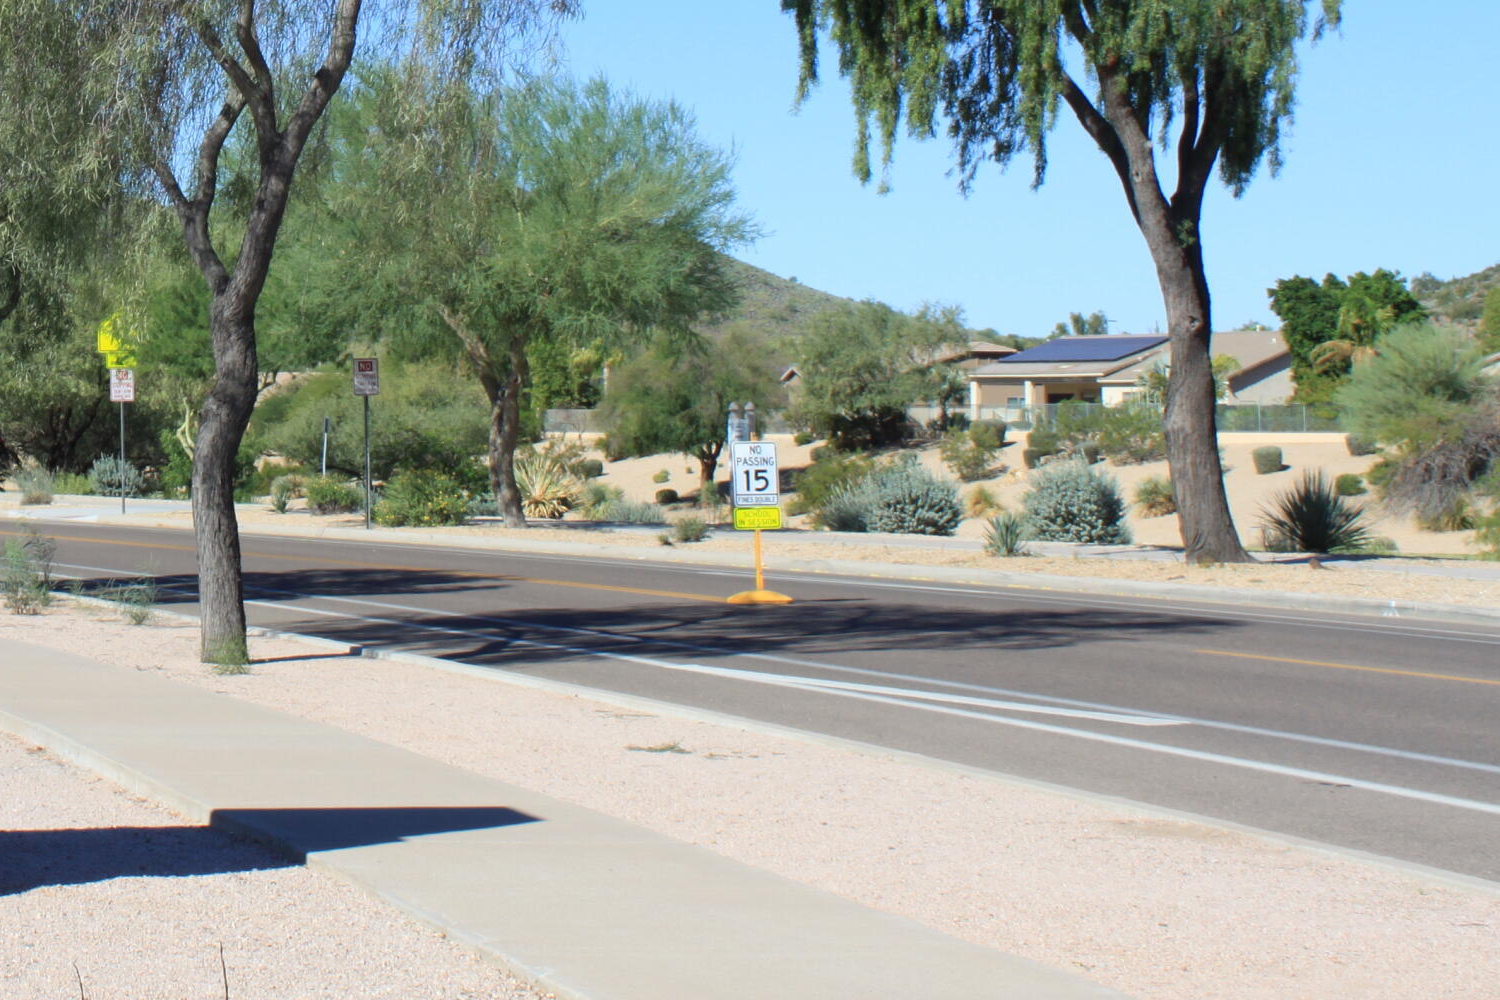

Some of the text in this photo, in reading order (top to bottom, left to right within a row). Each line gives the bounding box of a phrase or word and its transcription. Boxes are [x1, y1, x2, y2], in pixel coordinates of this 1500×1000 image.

[749, 445, 762, 455] NO
[736, 456, 775, 467] PASSING
[743, 469, 770, 492] 15
